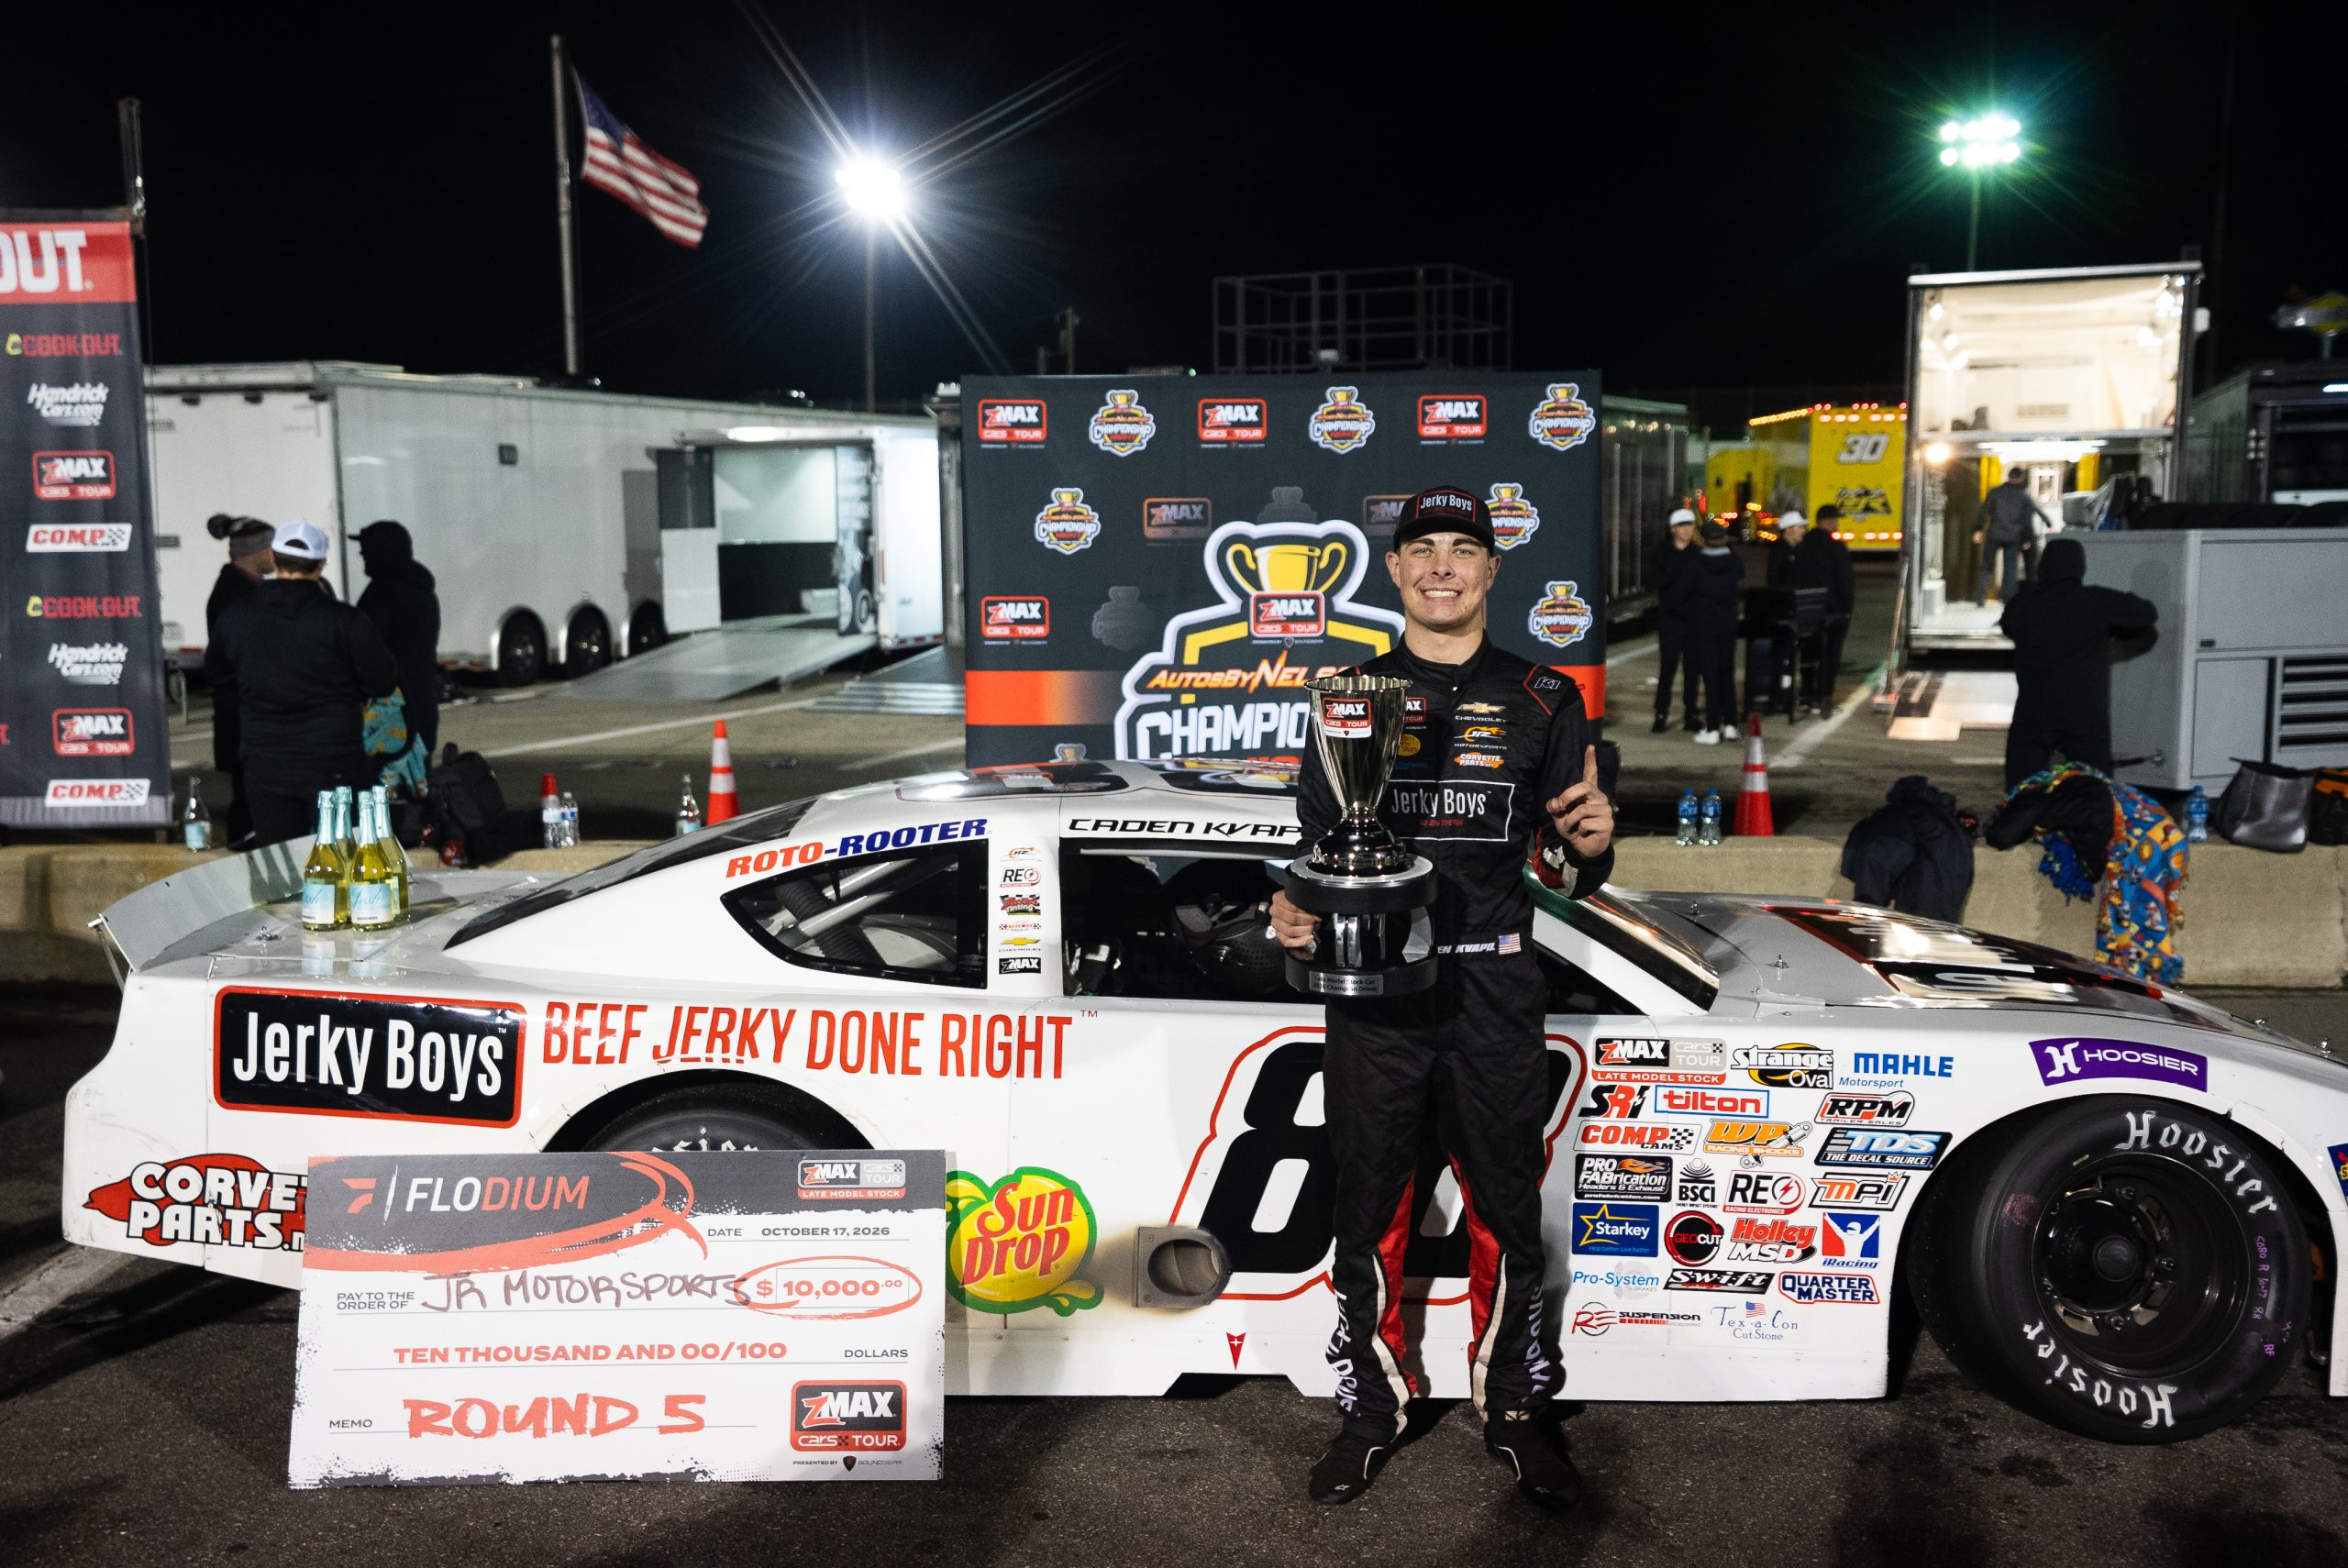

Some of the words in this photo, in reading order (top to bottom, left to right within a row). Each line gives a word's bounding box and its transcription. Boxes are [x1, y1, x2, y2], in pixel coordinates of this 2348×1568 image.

[23, 334, 79, 357] COOK
[82, 333, 120, 357] OUT
[28, 382, 109, 409] Hendrick
[1014, 430, 1042, 438] TOUR
[1234, 429, 1262, 438] TOUR
[1455, 425, 1482, 434] TOUR
[1534, 417, 1590, 434] CHAMPIONSHIP
[1837, 434, 1890, 463] 30
[1420, 495, 1448, 510] Jerky
[1449, 494, 1473, 512] Boys
[33, 529, 106, 545] COMP
[44, 597, 101, 618] COOK
[102, 596, 141, 618] OUT
[1017, 626, 1045, 635] TOUR
[1534, 614, 1589, 631] CHAMPIONSHIP
[48, 643, 128, 668] Hendrick
[1455, 715, 1508, 723] CHEVROLET
[1136, 702, 1311, 759] CHAMPIO
[96, 743, 129, 753] TOUR
[1460, 754, 1501, 762] CORVETTE
[52, 785, 124, 800] COMP
[1391, 788, 1438, 817] Jerky
[1444, 789, 1487, 817] Boys
[1069, 818, 1195, 834] CADEN
[1202, 822, 1302, 838] KVAP
[725, 819, 989, 878] ROTO-ROOTER
[1455, 943, 1496, 954] KVAPIL
[1327, 977, 1346, 985] Model
[543, 1001, 648, 1065] BEEF
[653, 1005, 797, 1065] JERKY
[805, 1010, 925, 1076] DONE
[939, 1013, 1073, 1079] RIGHT
[233, 1011, 373, 1094] Jerky
[386, 1019, 504, 1102] Boys
[1678, 1055, 1721, 1066] TOUR
[1731, 1044, 1833, 1070] Strange
[1854, 1053, 1954, 1077] MAHLE
[2083, 1049, 2199, 1077] HOOSIER
[1597, 1072, 1627, 1080] LATE
[1632, 1073, 1674, 1082] MODEL
[1678, 1075, 1720, 1083] STOCK
[1789, 1070, 1833, 1088] Oval
[1839, 1077, 1904, 1089] Motorsport
[1663, 1090, 1761, 1114] tilton
[1826, 1098, 1912, 1119] RPM
[1581, 1125, 1669, 1145] COMP
[1707, 1121, 1790, 1145] WP
[1641, 1142, 1684, 1151] CAMS
[1707, 1144, 1750, 1153] RACING
[1753, 1147, 1800, 1155] SHOCKS
[1844, 1130, 1943, 1155] TDS
[1583, 1157, 1618, 1172] PRO
[1826, 1153, 1846, 1161] THE
[1848, 1154, 1881, 1164] DECAL
[1885, 1155, 1928, 1165] SOURCE
[2114, 1110, 2277, 1215] Hoosier
[865, 1174, 901, 1184] TOUR
[405, 1176, 590, 1212] FLODIUM
[1678, 1185, 1715, 1202] BSCI
[976, 1183, 1075, 1238] Sun
[127, 1200, 305, 1252] PARTS.n
[707, 1228, 743, 1237] DATE
[761, 1227, 830, 1236] OCTOBER
[833, 1228, 850, 1238] 17,
[853, 1227, 890, 1236] 2026
[1596, 1221, 1650, 1240] Starkey
[1733, 1218, 1817, 1248] Holley
[1674, 1233, 1722, 1244] GEOCUT
[959, 1226, 1070, 1287] Drop
[1727, 1242, 1803, 1264] MSD
[1822, 1257, 1878, 1269] iRacing
[1572, 1271, 1659, 1287] Pro-System
[1782, 1275, 1870, 1292] QUARTER
[337, 1292, 362, 1301] PAY
[365, 1292, 382, 1301] TO
[386, 1291, 415, 1300] THE
[421, 1272, 487, 1313] JR
[504, 1269, 751, 1309] MOTORSPORTS
[1798, 1287, 1875, 1301] MASTER
[337, 1301, 386, 1310] ORDER
[390, 1300, 409, 1309] OF
[1619, 1311, 1700, 1320] SUSPENSION
[1733, 1328, 1753, 1339] Cut
[1755, 1329, 1783, 1340] Stone
[393, 1347, 449, 1364] TEN
[454, 1344, 611, 1364] THOUSAND
[615, 1343, 676, 1360] AND
[681, 1342, 787, 1361] 00/100
[845, 1349, 909, 1359] DOLLARS
[2264, 1343, 2275, 1357] RF
[2022, 1320, 2177, 1430] Hoosier
[328, 1419, 373, 1429] MEMO
[402, 1393, 639, 1440] ROUND
[658, 1395, 706, 1435] 5
[852, 1434, 900, 1447] TOUR
